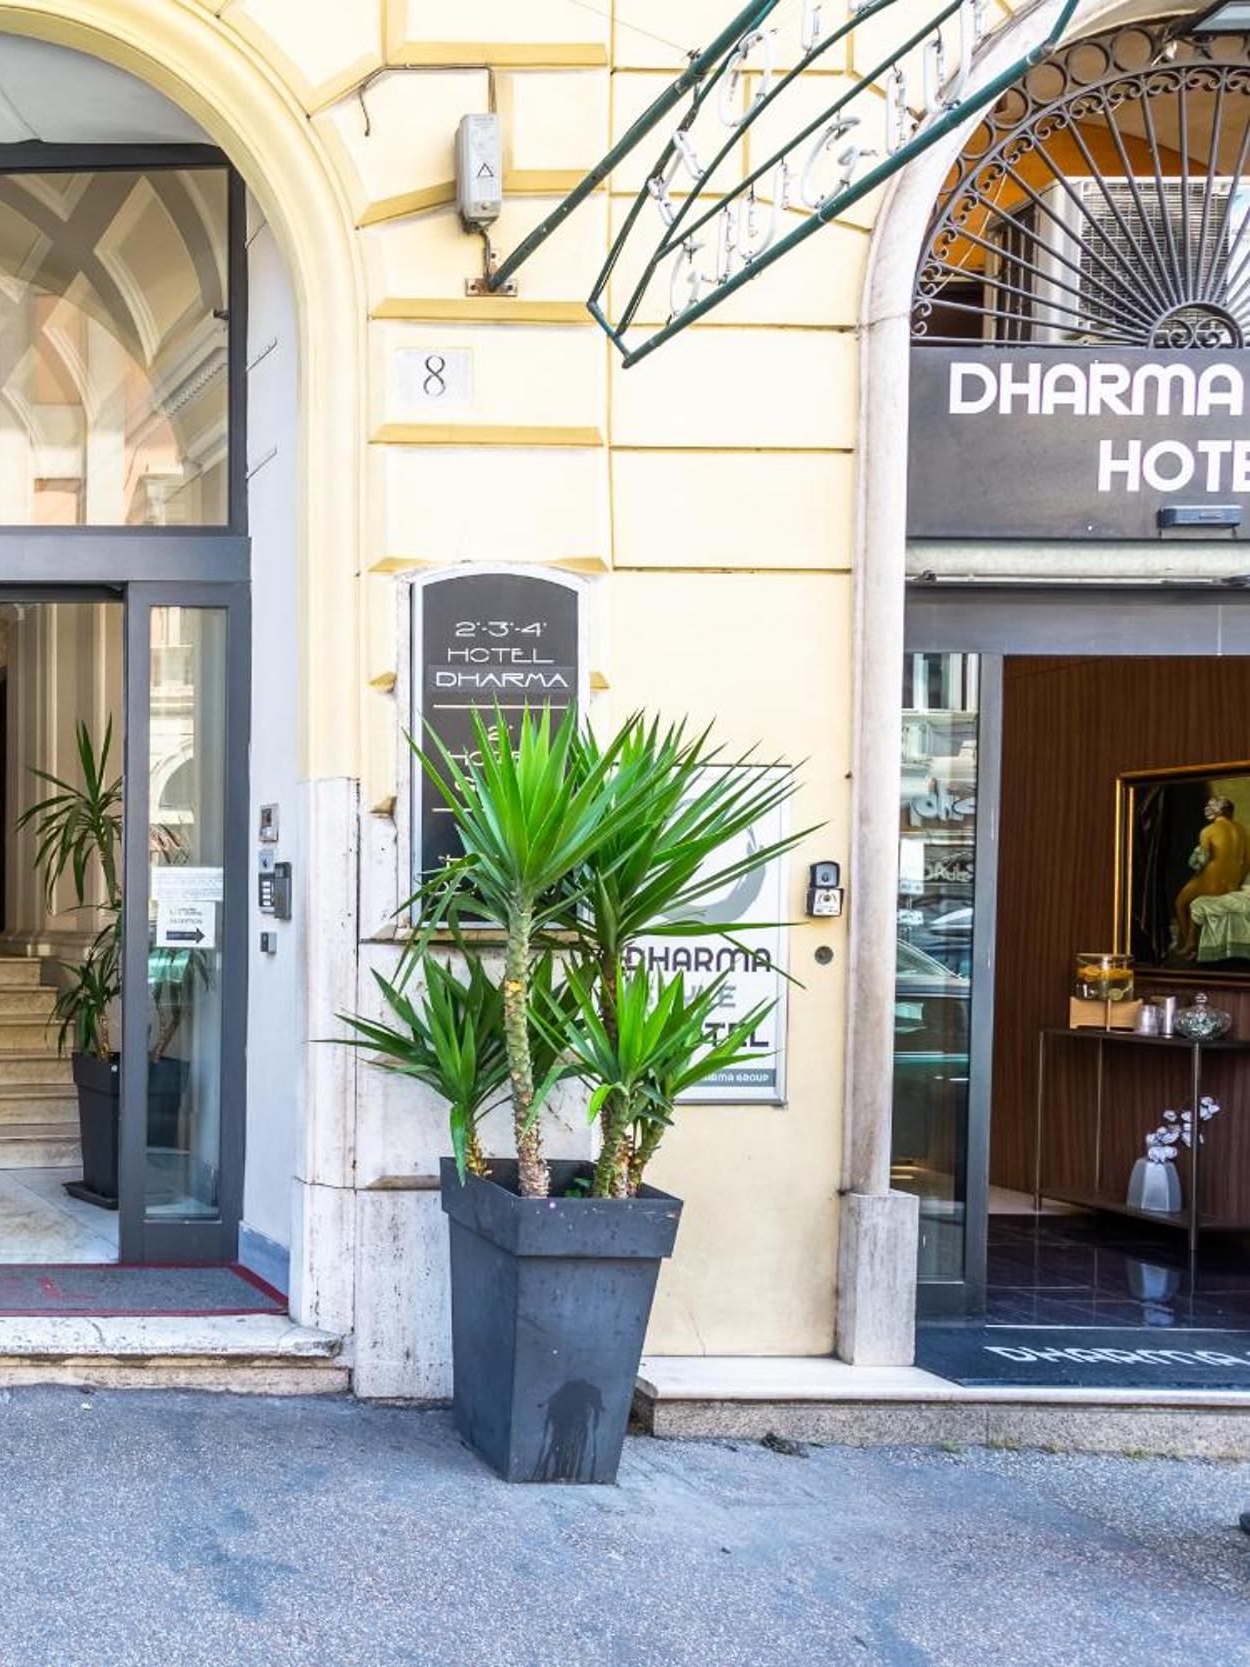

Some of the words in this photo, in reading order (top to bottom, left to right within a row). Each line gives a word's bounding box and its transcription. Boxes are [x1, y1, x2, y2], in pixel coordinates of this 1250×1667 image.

[423, 355, 446, 397] 8
[949, 362, 1244, 416] DHARMA
[447, 648, 554, 663] HOTEL
[436, 671, 568, 688] DHARMA
